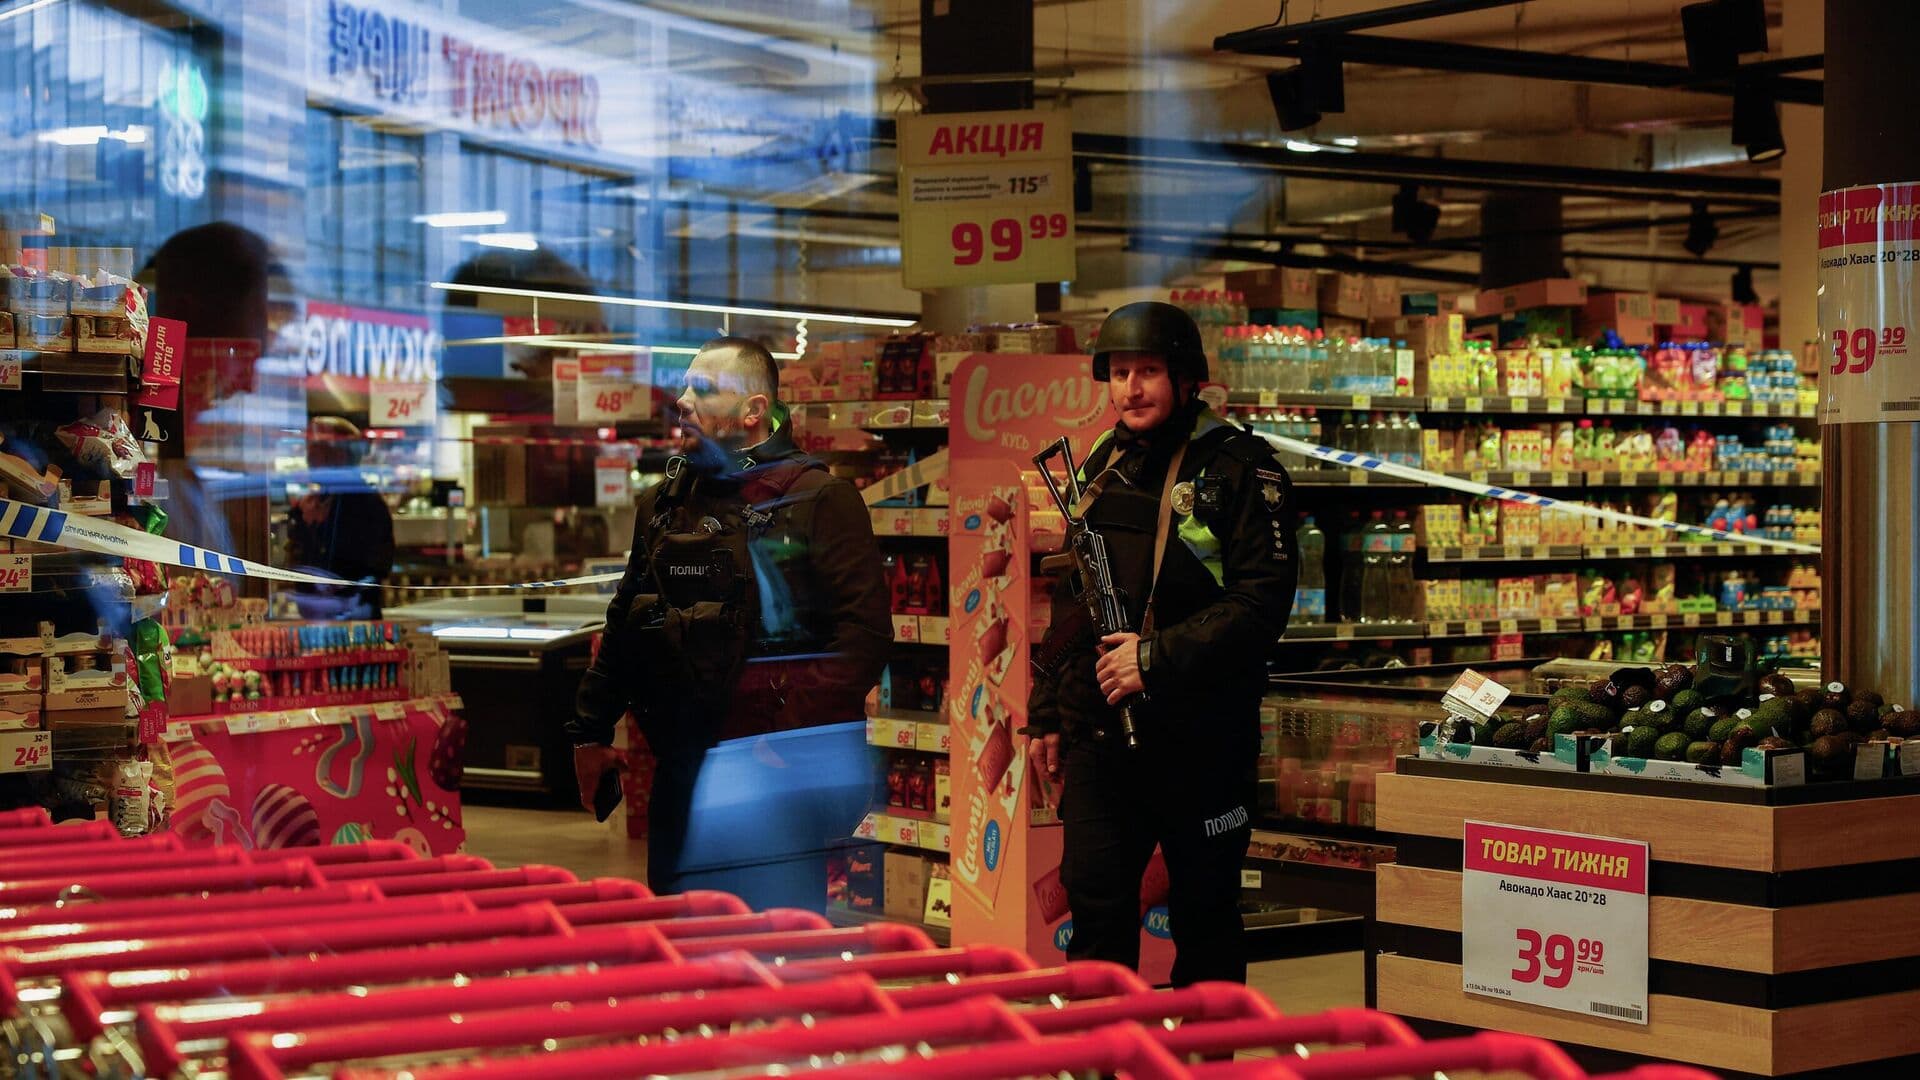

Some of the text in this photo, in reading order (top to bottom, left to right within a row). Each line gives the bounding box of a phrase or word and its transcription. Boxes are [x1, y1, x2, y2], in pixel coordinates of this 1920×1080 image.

[928, 122, 1044, 157] АКЦІЯ
[1008, 176, 1038, 194] 115
[951, 213, 1068, 266] 99 99
[1849, 252, 1876, 265] Хаас
[155, 325, 167, 351] ДЛЯ
[1830, 326, 1906, 376] 39 99
[596, 391, 622, 412] 48
[1001, 432, 1029, 450] КУСЬ
[898, 730, 910, 744] 68
[15, 746, 39, 766] 24
[1204, 805, 1249, 837] ПОЛІЦІЯ
[900, 827, 912, 841] 68
[1481, 838, 1630, 879] ТОВАР ТИЖНЯ
[1499, 879, 1545, 897] Авокадо
[1546, 886, 1572, 901] Хаас
[1147, 912, 1171, 932] КУС
[1511, 928, 1604, 989] 39 99
